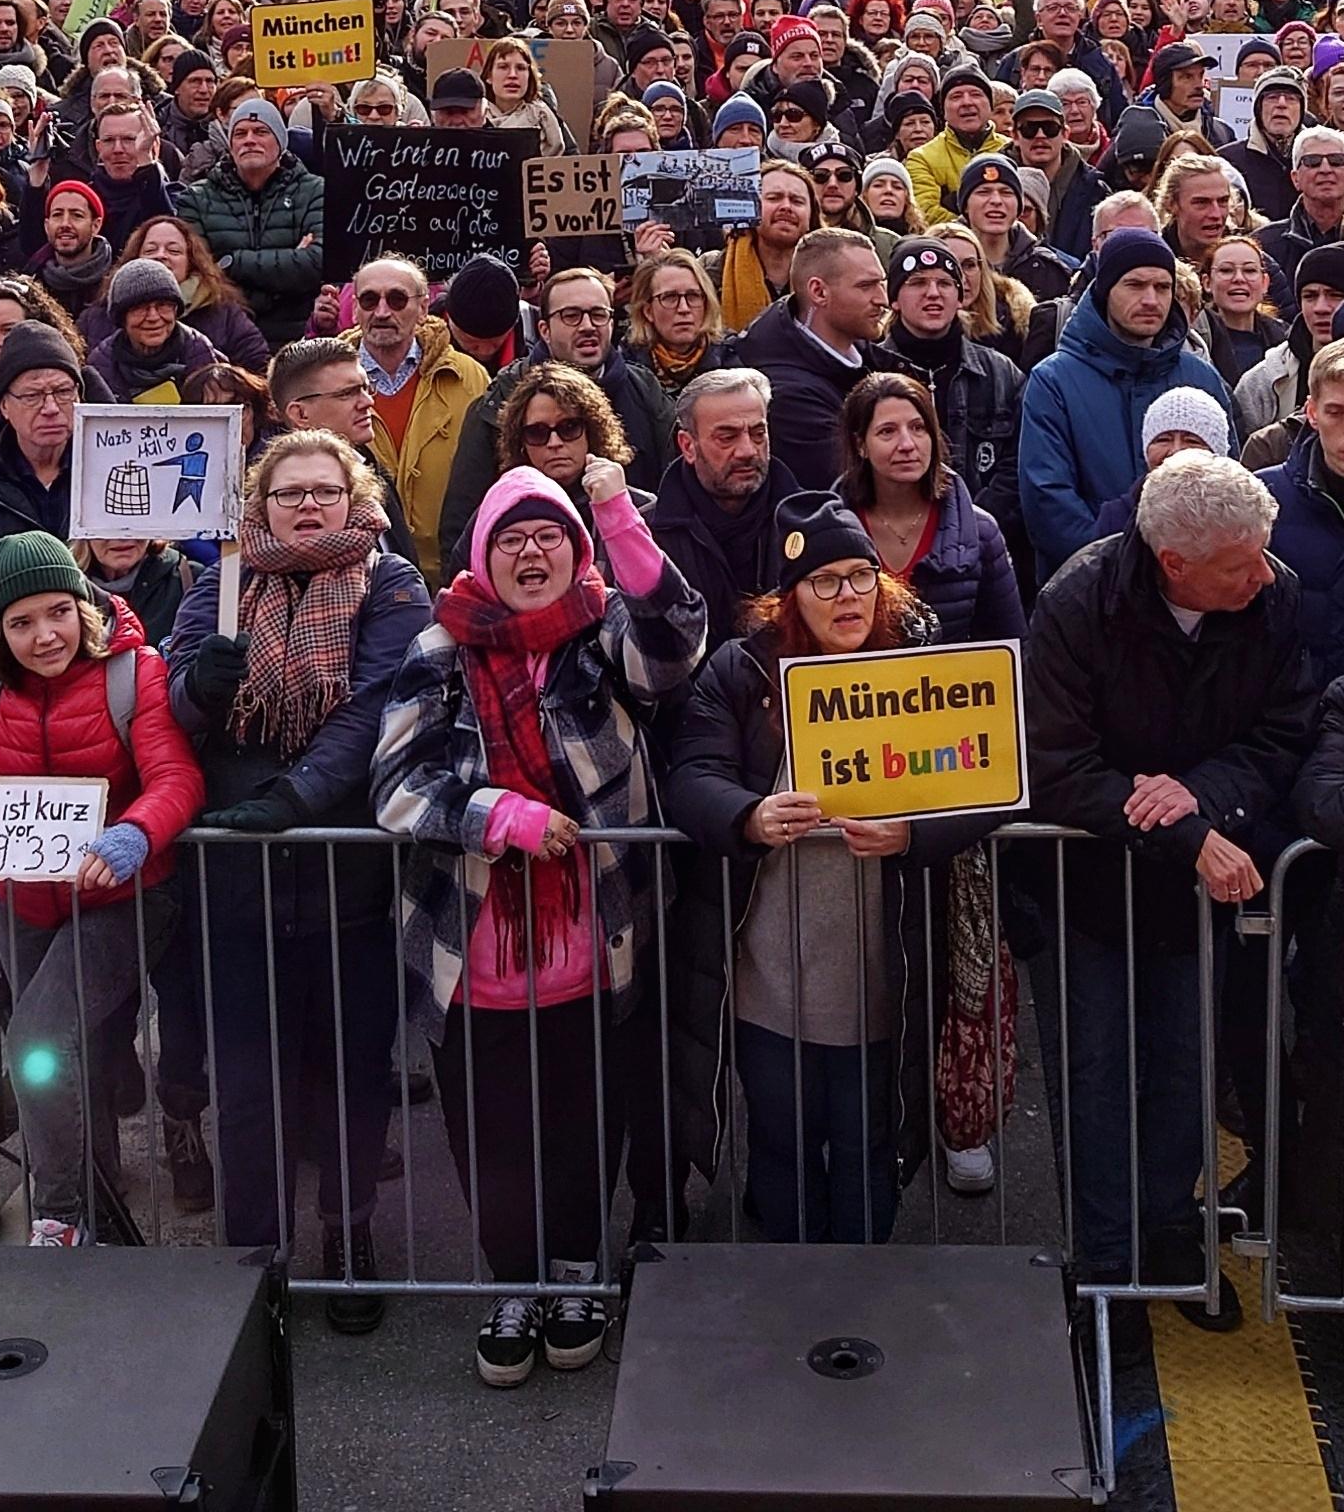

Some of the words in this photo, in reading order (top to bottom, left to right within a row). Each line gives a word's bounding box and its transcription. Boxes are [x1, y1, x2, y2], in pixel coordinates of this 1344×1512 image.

[262, 12, 365, 37] München
[268, 49, 296, 69] ist
[303, 42, 361, 68] bunt!
[336, 136, 385, 169] Wir
[470, 148, 511, 170] nur
[365, 172, 501, 210] Gartenzwerge
[527, 163, 564, 194] Es
[573, 158, 612, 192] ist
[347, 204, 418, 235] Nazis
[429, 204, 470, 243] auf
[469, 209, 501, 236] die
[529, 199, 548, 232] 5
[96, 429, 132, 448] Nazis
[140, 423, 169, 440] sind
[808, 675, 996, 724] München
[821, 748, 871, 786] ist
[881, 733, 990, 779] bunt!
[2, 790, 31, 821] ist
[35, 790, 90, 821] kurz
[5, 825, 35, 838] vor
